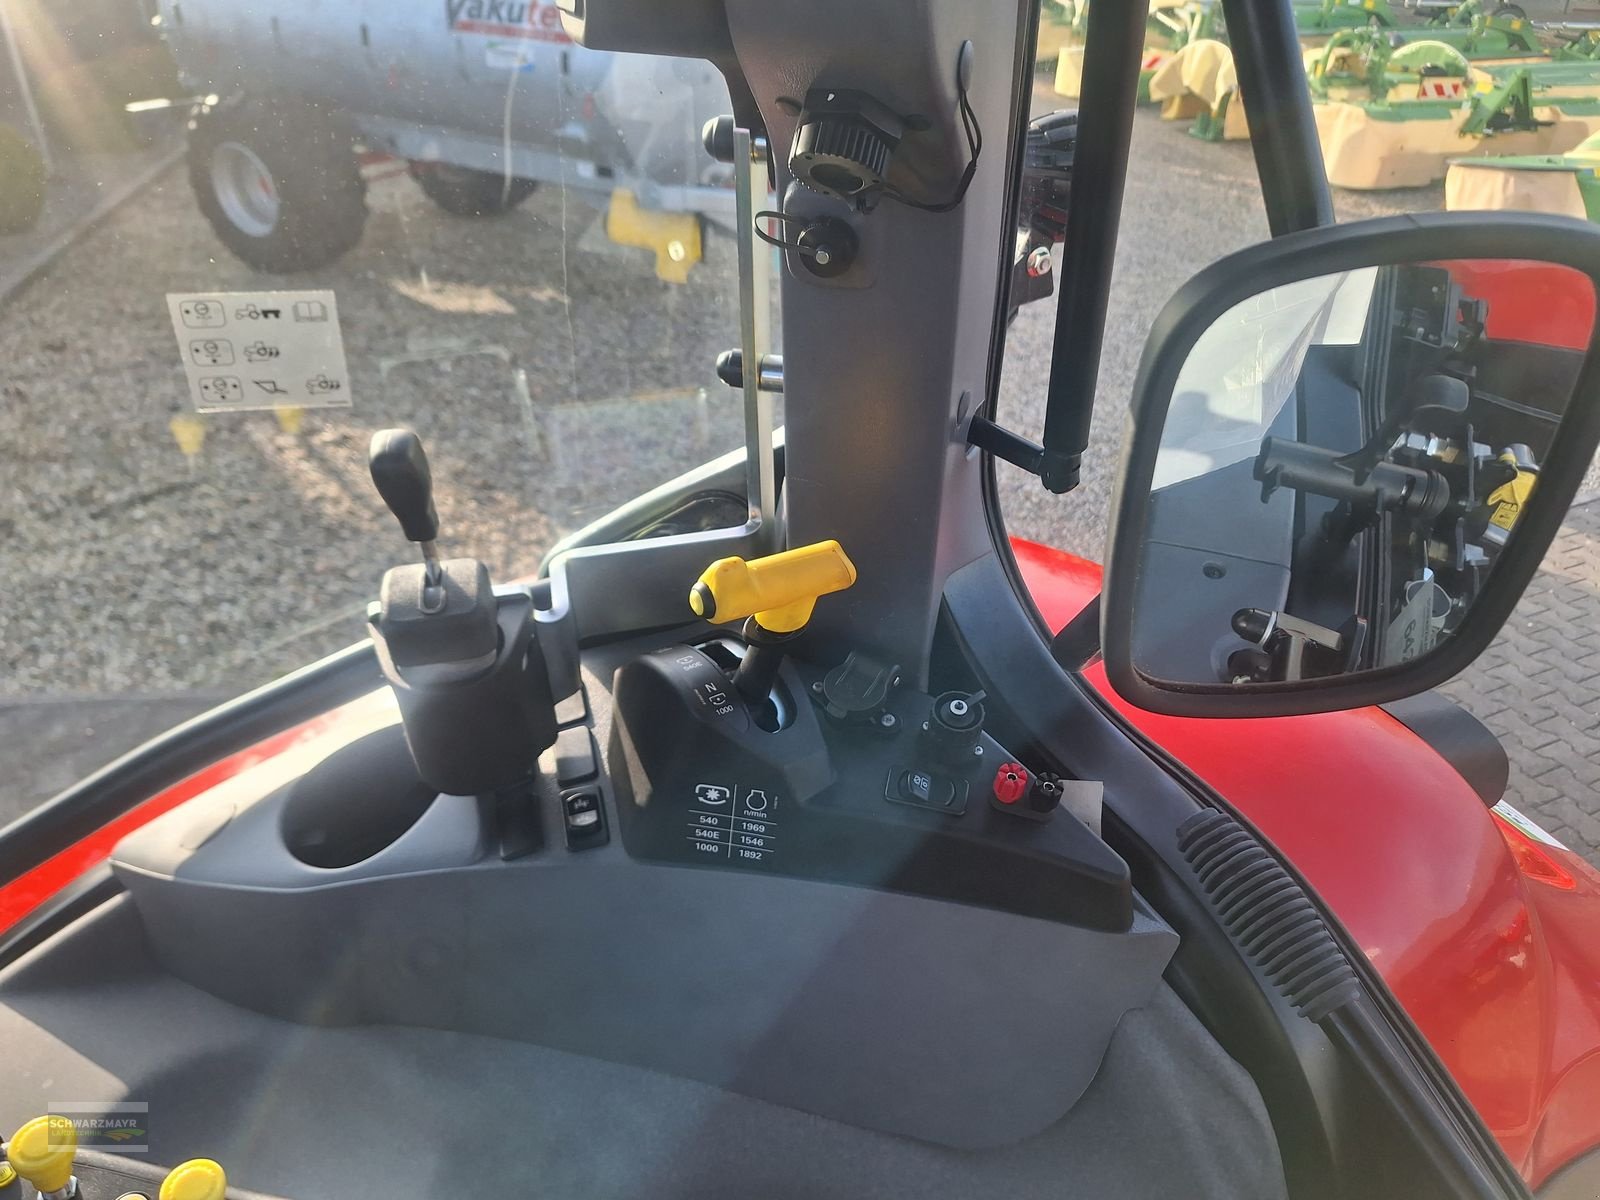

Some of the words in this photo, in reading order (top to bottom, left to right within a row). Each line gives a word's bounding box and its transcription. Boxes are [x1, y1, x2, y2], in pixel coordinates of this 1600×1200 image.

[704, 682, 717, 693] N
[715, 704, 734, 716] 1000
[743, 809, 767, 819] n/min
[699, 815, 718, 826] 540
[695, 828, 720, 840] 540E
[742, 822, 766, 834] 1969
[740, 835, 764, 848] 1546
[695, 842, 719, 854] 1000
[739, 849, 762, 862] 1892
